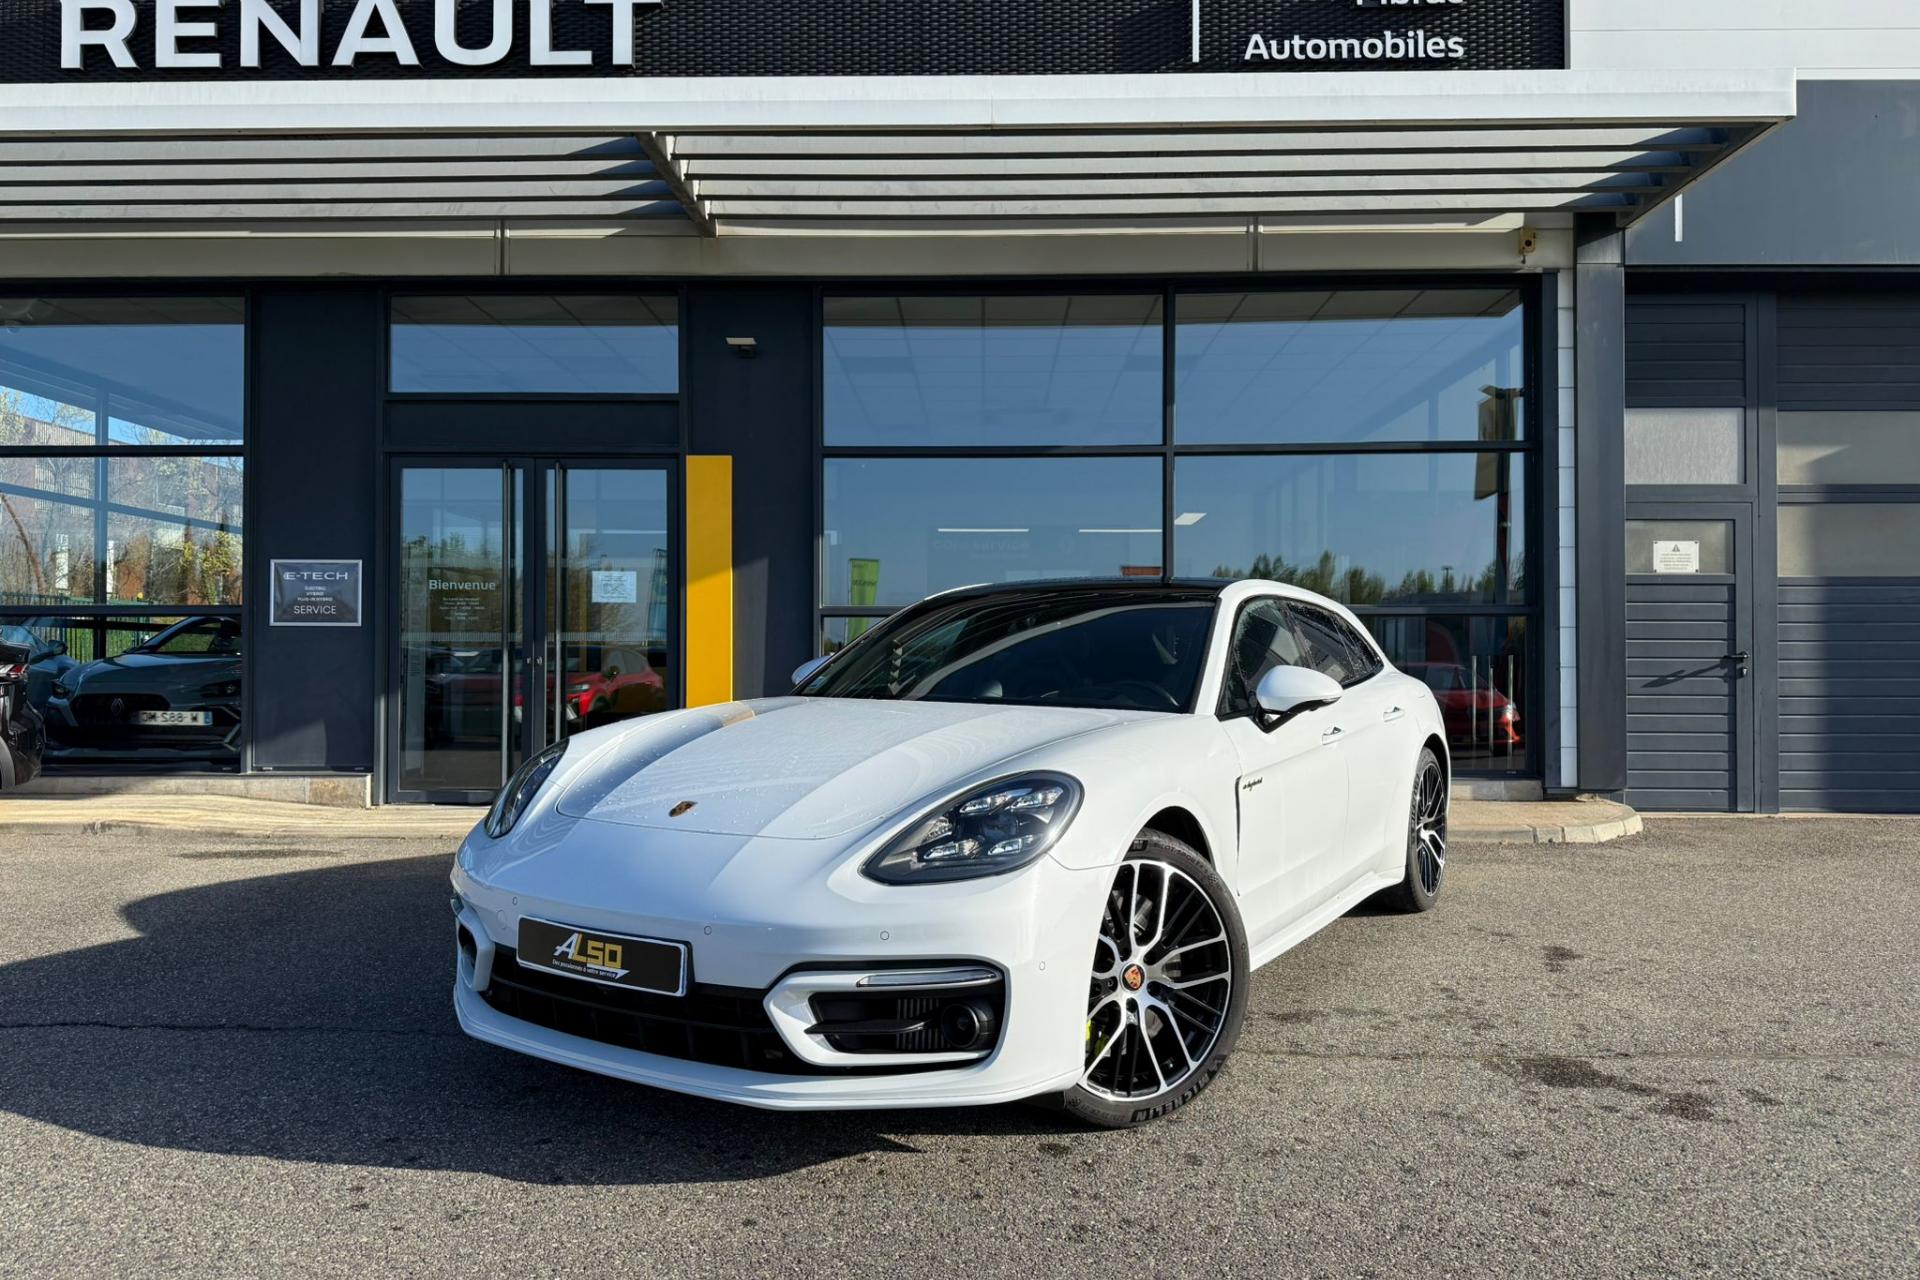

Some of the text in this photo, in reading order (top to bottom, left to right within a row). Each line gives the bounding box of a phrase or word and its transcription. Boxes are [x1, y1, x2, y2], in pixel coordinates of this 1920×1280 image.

[59, 0, 664, 69] RENAULT
[1244, 30, 1465, 60] Automobiles
[283, 571, 349, 581] E-TECH
[428, 579, 496, 591] Bienvenue
[293, 605, 337, 615] SERVICE
[1135, 1073, 1210, 1122] MICHELIN
